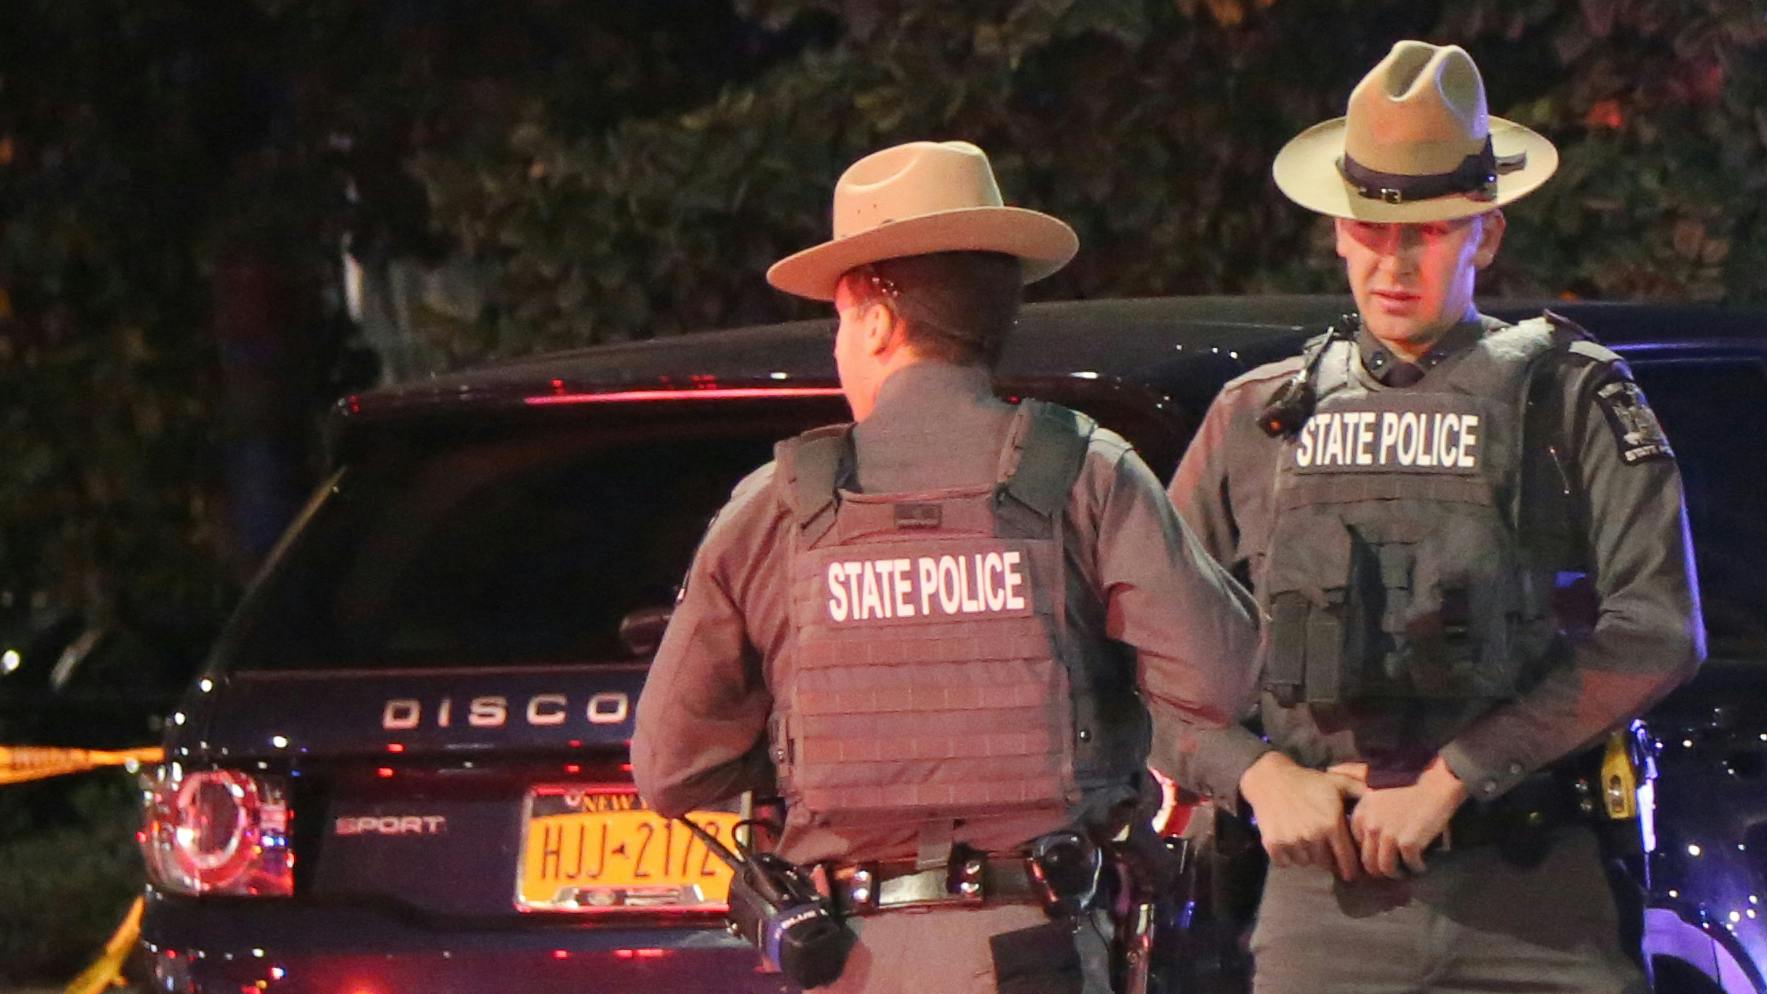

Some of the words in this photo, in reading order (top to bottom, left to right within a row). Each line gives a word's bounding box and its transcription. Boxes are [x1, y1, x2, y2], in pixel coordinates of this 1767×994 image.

[1296, 412, 1377, 467] STATE
[1379, 412, 1479, 467] POLICE
[828, 558, 915, 622] STATE
[918, 552, 1025, 616] POLICE
[335, 816, 447, 835] SPORT
